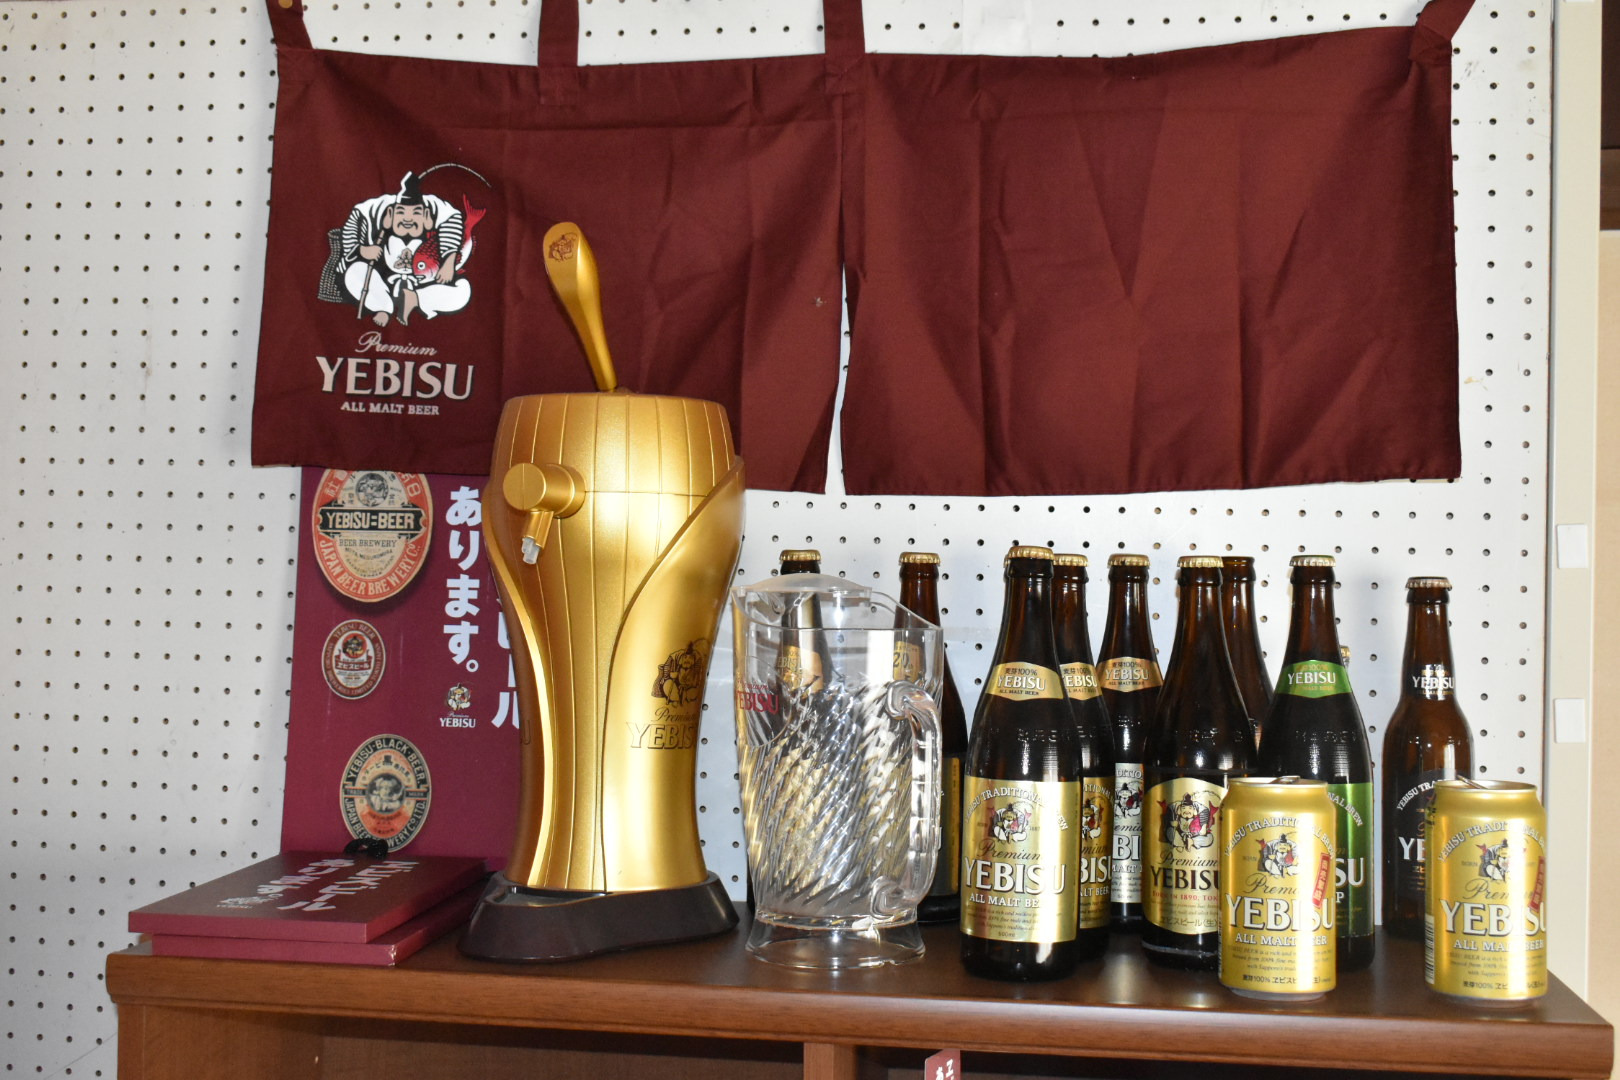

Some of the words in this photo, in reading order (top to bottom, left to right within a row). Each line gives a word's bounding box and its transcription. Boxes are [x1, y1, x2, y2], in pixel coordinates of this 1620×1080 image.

[355, 331, 437, 356] Premium
[316, 356, 474, 399] YEBISU
[341, 401, 366, 413] ALL
[369, 402, 404, 415] MALT
[407, 404, 440, 416] BEER
[320, 540, 341, 577] JAPAN
[337, 569, 366, 596] BEER
[444, 485, 482, 673] あります。
[1062, 675, 1098, 688] EBISU
[1105, 669, 1149, 680] YEBISU
[1287, 671, 1336, 685] YEBISU
[1412, 675, 1455, 690] YEBSU
[998, 675, 1047, 691] YEBISU
[440, 718, 476, 728] YEBISU
[626, 722, 696, 750] YEBIS
[347, 746, 374, 780] YEBISU
[375, 739, 408, 754] BLACK
[981, 787, 1043, 805] TRADITIONA
[1397, 787, 1419, 811] YEBISU
[1344, 805, 1363, 828] BREW
[1159, 852, 1218, 868] Premium
[964, 855, 1067, 896] YEBISU
[1095, 886, 1110, 896] BEER
[969, 892, 985, 904] ALL
[988, 895, 1021, 908] MALT
[1439, 899, 1547, 939] YEBSU
[1236, 934, 1257, 945] ALL
[1261, 936, 1296, 946] MALT
[1454, 938, 1478, 950] ALL
